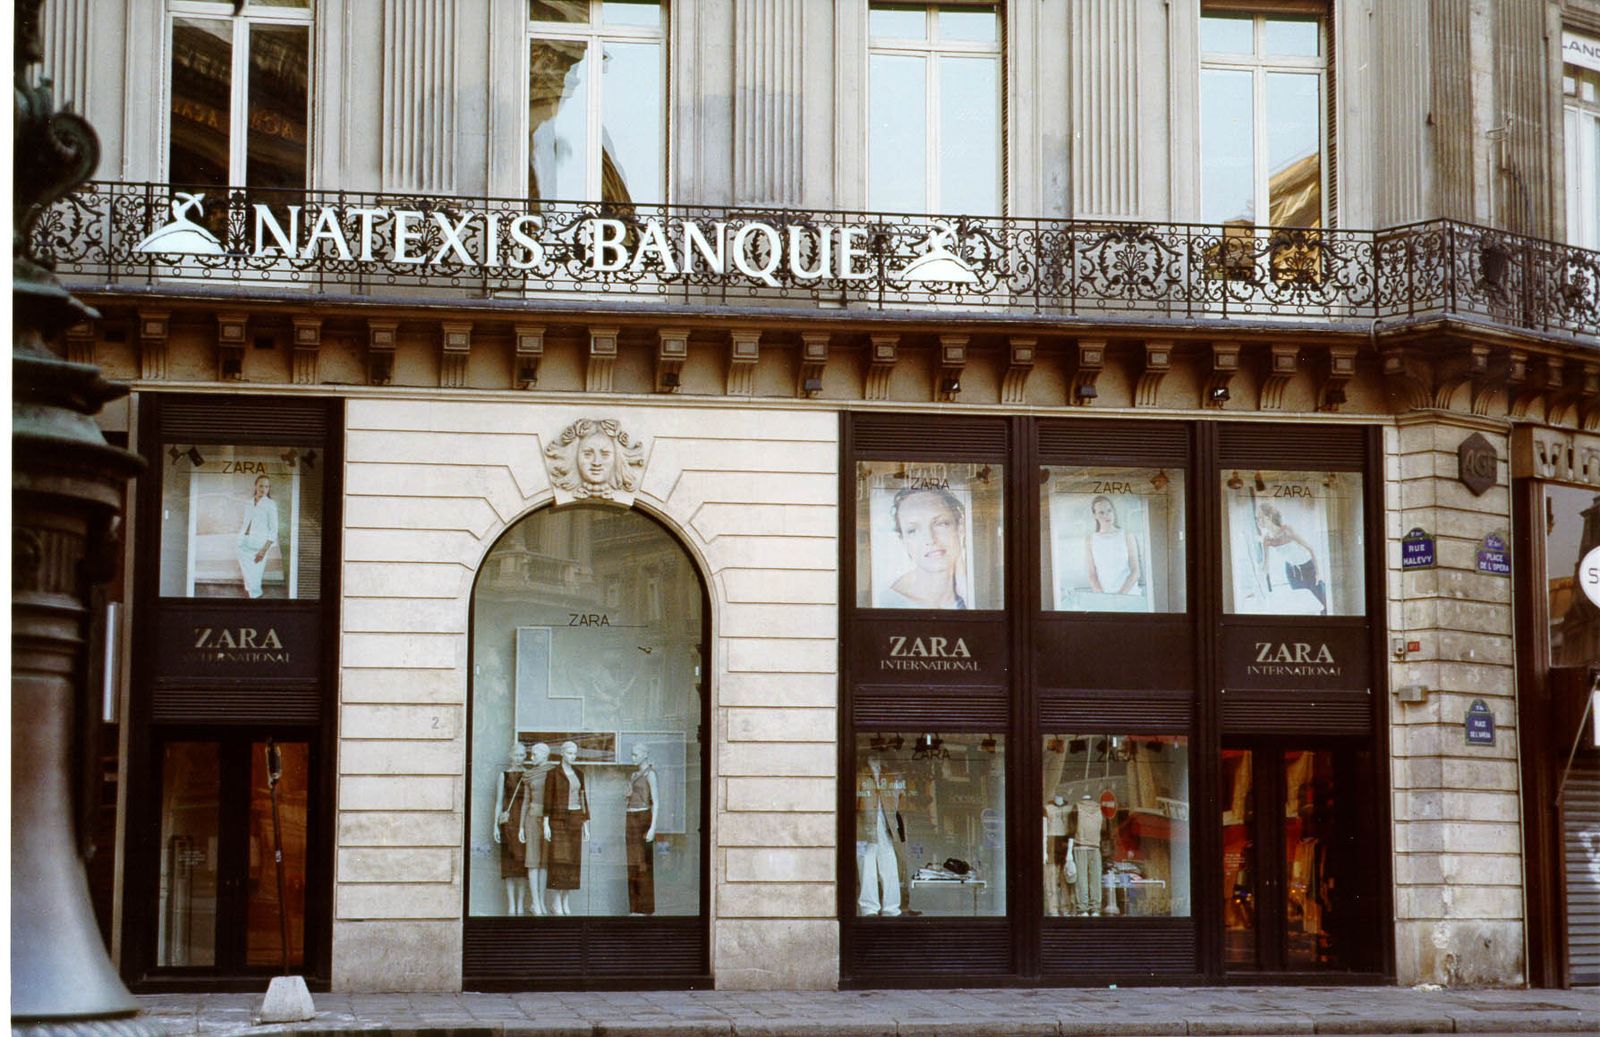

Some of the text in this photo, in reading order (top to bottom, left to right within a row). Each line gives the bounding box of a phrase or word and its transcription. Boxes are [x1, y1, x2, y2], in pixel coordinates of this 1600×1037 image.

[252, 203, 870, 287] NATEXIS BANQUE
[222, 460, 266, 474] ZARA
[911, 477, 950, 490] ZARA
[1092, 481, 1133, 494] ZARA
[1273, 485, 1312, 498] ZARA
[1408, 544, 1425, 553] RUE
[569, 613, 610, 627] ZARA
[194, 628, 283, 649] ZARA
[889, 636, 971, 657] ZARA
[1255, 642, 1335, 662] ZARA
[880, 659, 981, 671] INTERNATIONAL
[1247, 665, 1342, 675] INTERNATIONAL
[432, 716, 439, 729] 2
